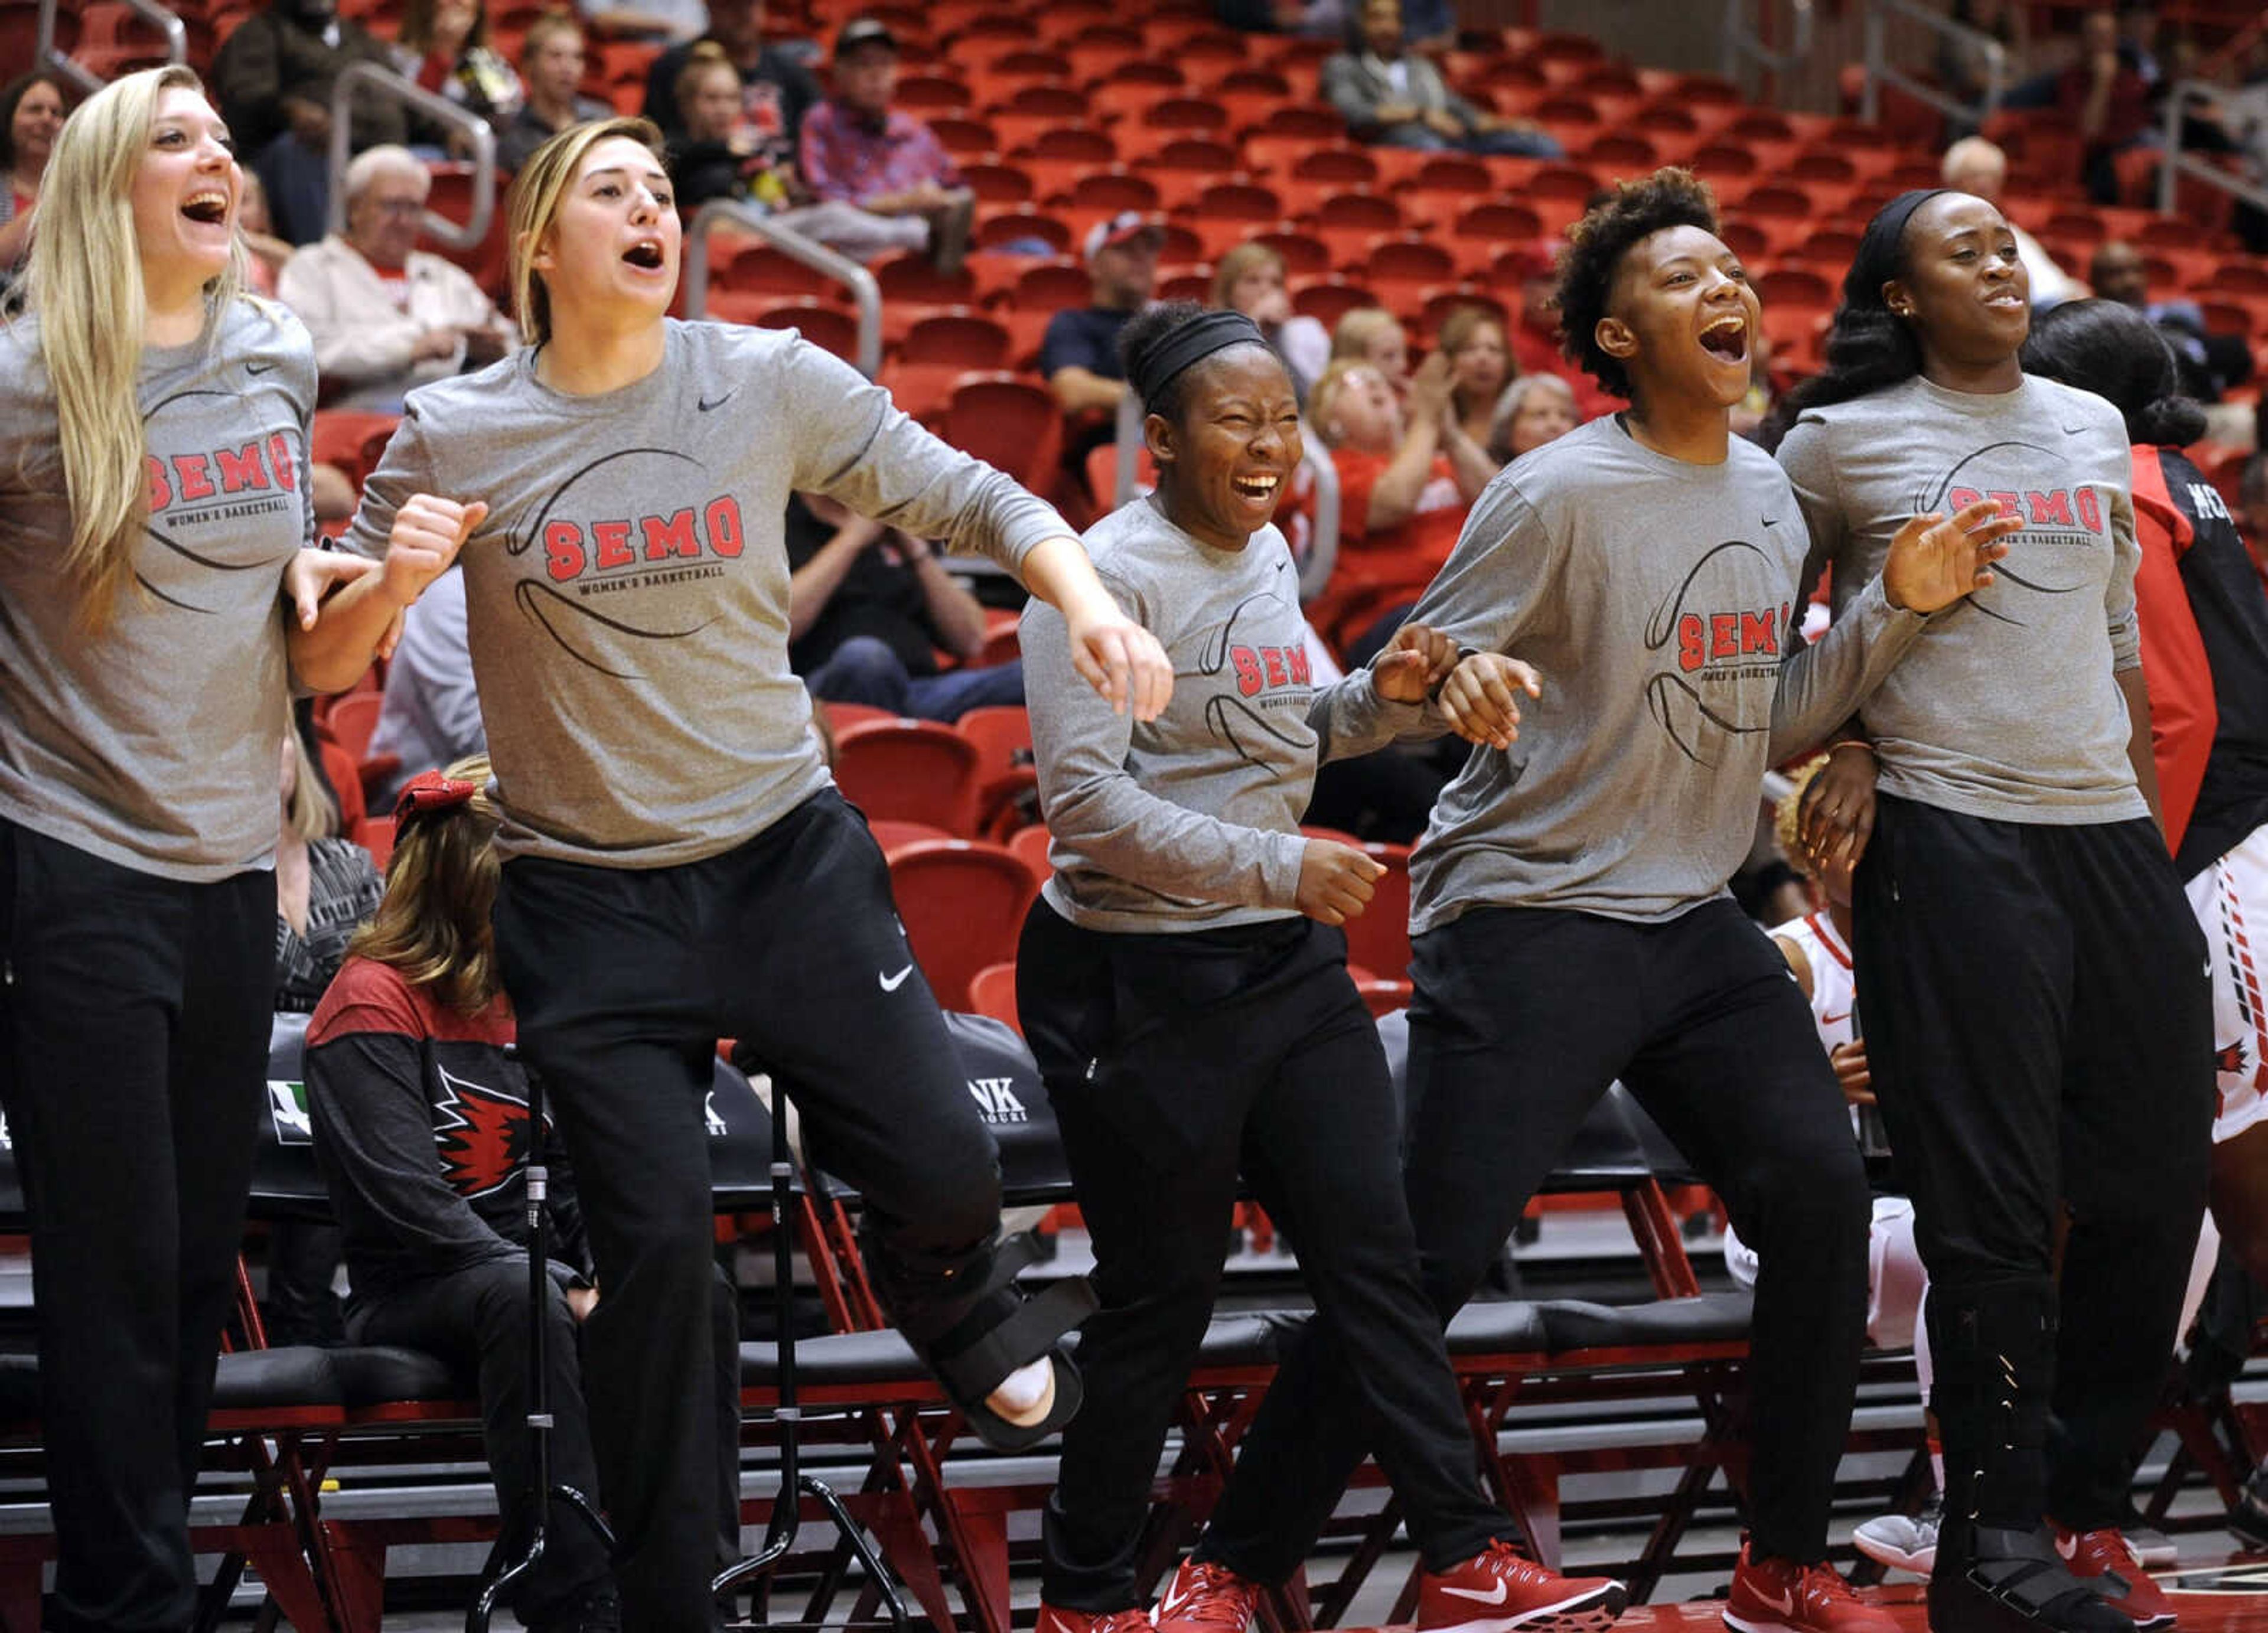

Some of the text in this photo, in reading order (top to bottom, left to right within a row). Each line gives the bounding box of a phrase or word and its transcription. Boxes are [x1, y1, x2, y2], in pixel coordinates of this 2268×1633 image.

[148, 431, 295, 513] SEMO
[165, 499, 289, 527] WOMEN'S BASKETBALL
[543, 493, 745, 584] SEMO
[2031, 534, 2093, 547] BASKETBALL
[578, 566, 725, 596] WOMEN'S BASKETBALL
